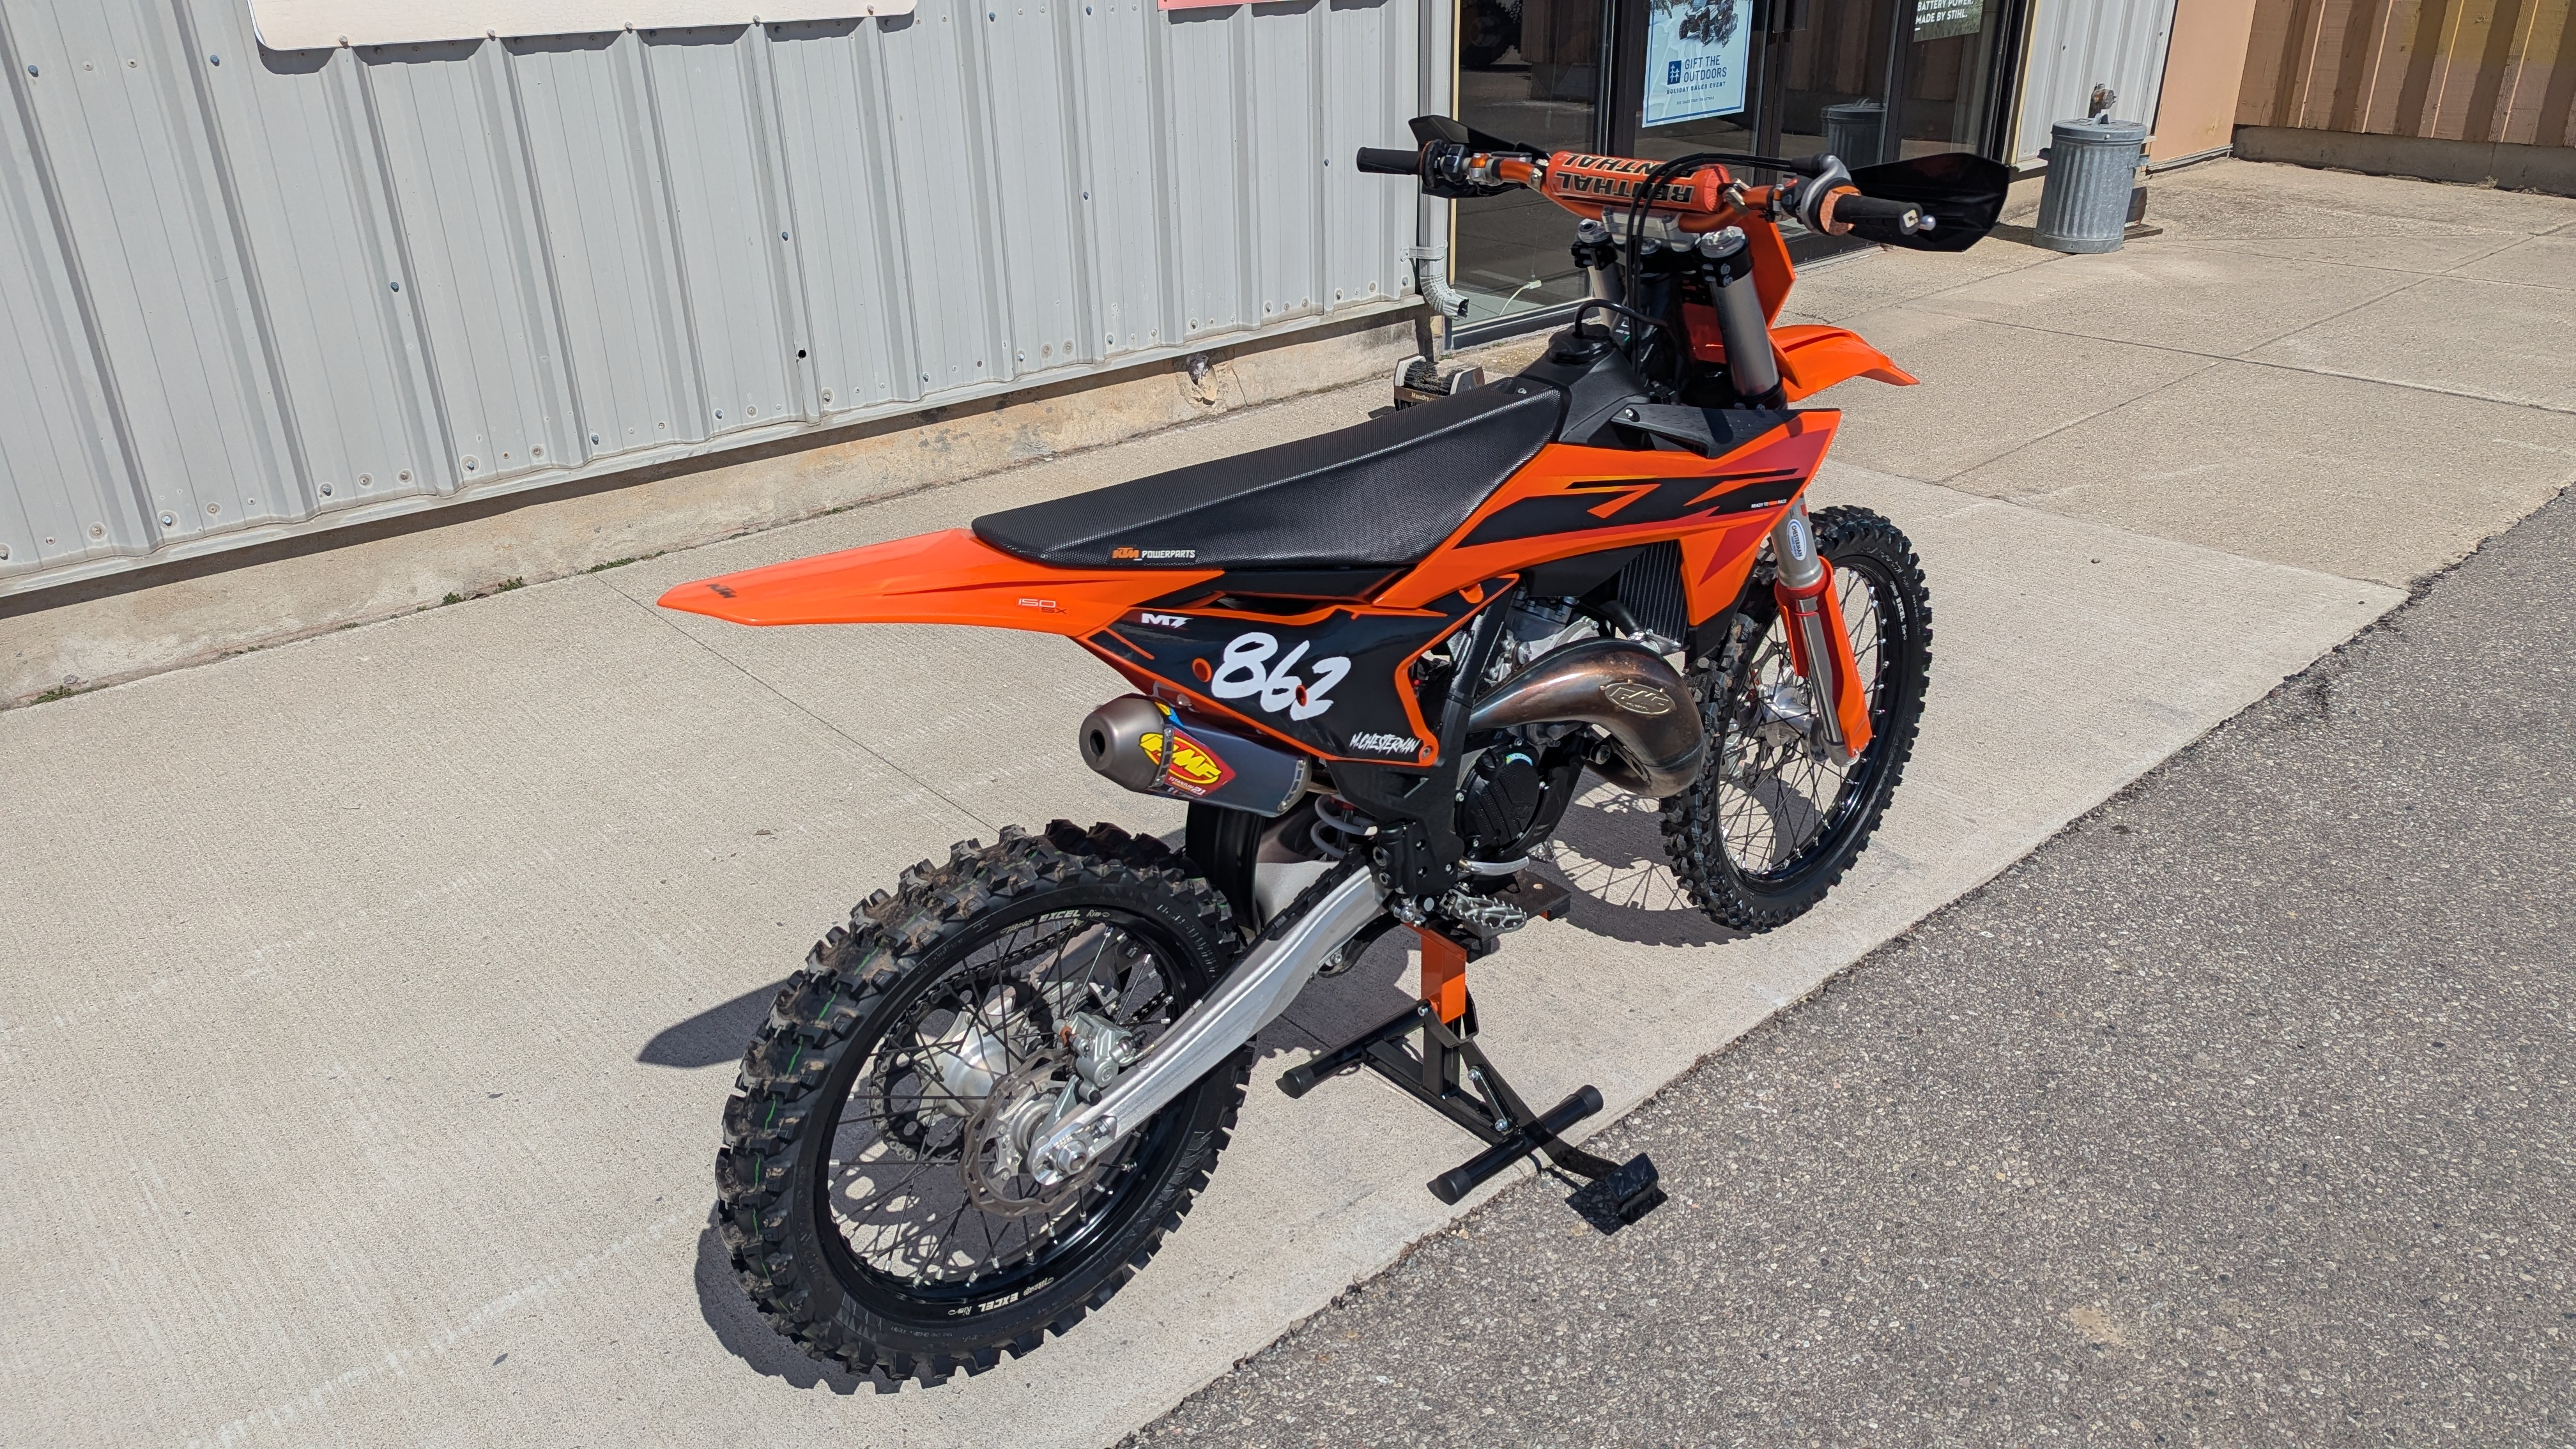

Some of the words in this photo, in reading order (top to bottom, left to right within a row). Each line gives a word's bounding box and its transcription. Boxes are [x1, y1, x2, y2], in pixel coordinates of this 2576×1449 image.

[1917, 0, 1948, 12] BATTERY
[1915, 12, 1935, 25] MADE
[1936, 11, 1947, 22] BY
[1946, 8, 1968, 20] STIHL.
[1684, 57, 1704, 70] GIFT
[1705, 54, 1721, 67] THE
[1683, 66, 1728, 83] OUTDOORS
[1666, 86, 1689, 95] HOLIDAY
[1709, 80, 1726, 89] EVENT
[1112, 547, 1140, 559] KTM
[1141, 549, 1195, 559] POWERPARTS
[1018, 598, 1056, 608] 150
[1895, 596, 1906, 622] EXCEL
[1211, 631, 1351, 721] 862
[1138, 734, 1222, 779] FMF
[1038, 909, 1082, 923] EXCEL
[977, 1291, 1019, 1312] EXCEL
